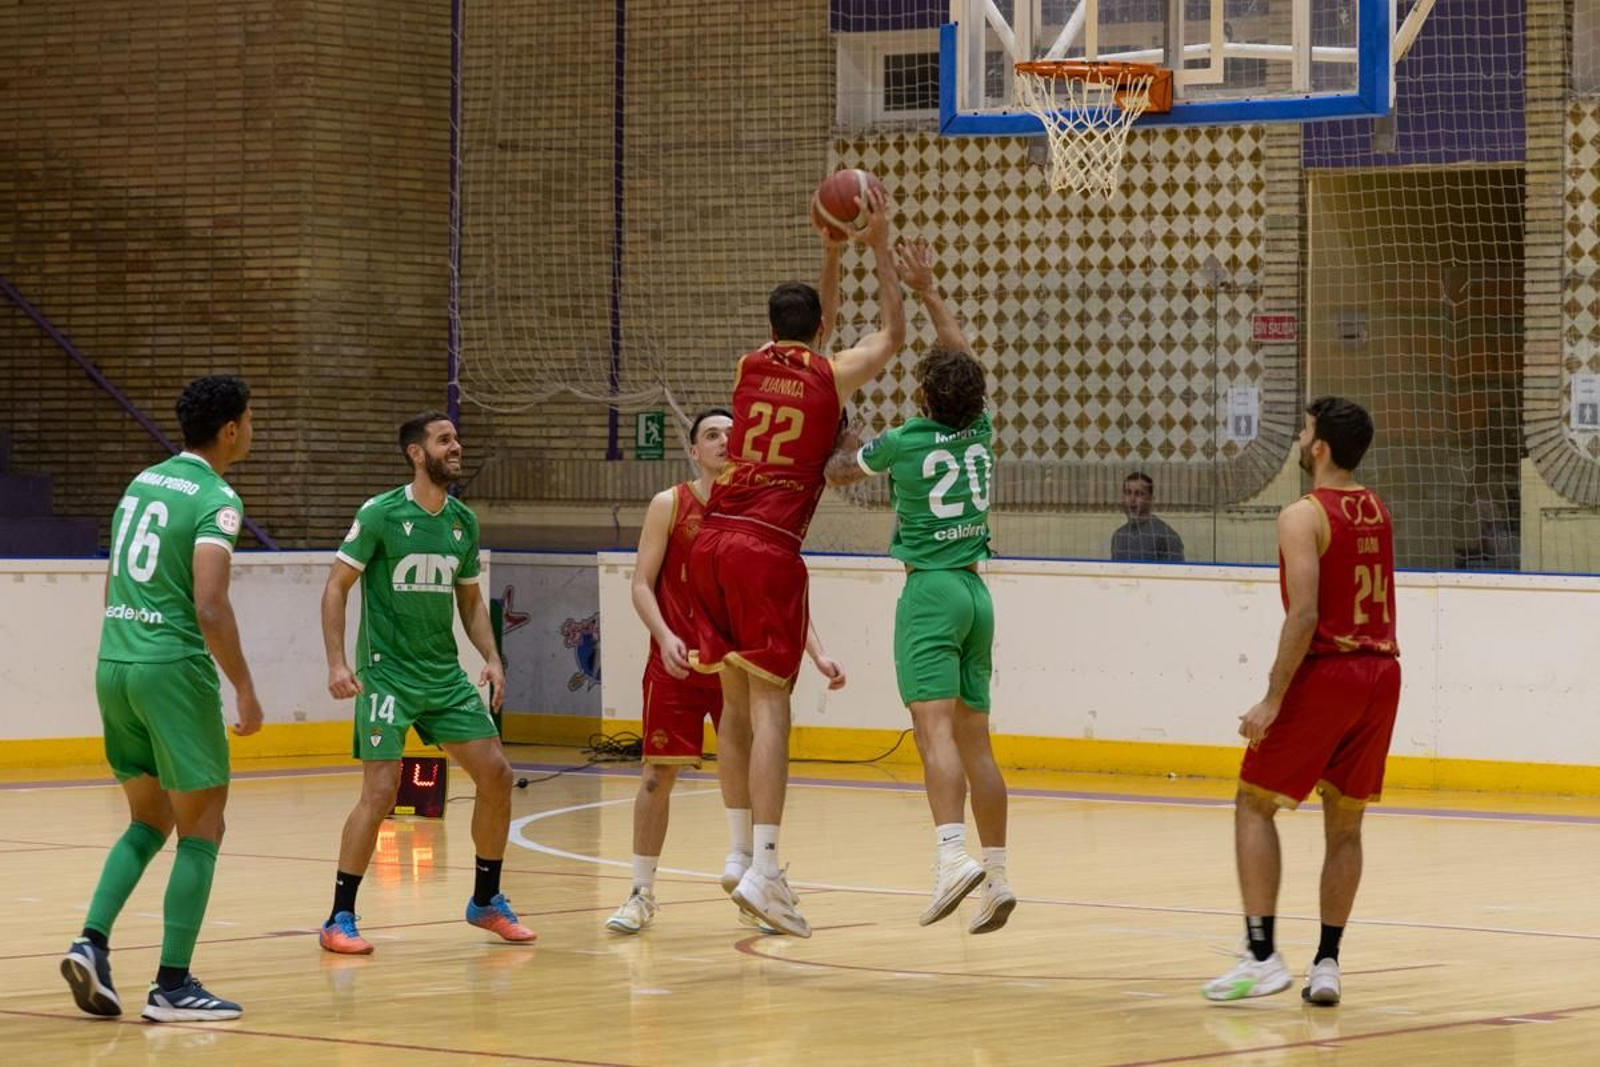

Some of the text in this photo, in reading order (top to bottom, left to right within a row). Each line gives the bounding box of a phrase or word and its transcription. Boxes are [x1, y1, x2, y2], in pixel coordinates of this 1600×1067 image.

[759, 376, 805, 399] JUANMA
[741, 402, 805, 466] 22
[922, 443, 992, 519] 20
[112, 495, 169, 583] 16
[1354, 563, 1391, 624] 24
[369, 692, 396, 724] 14
